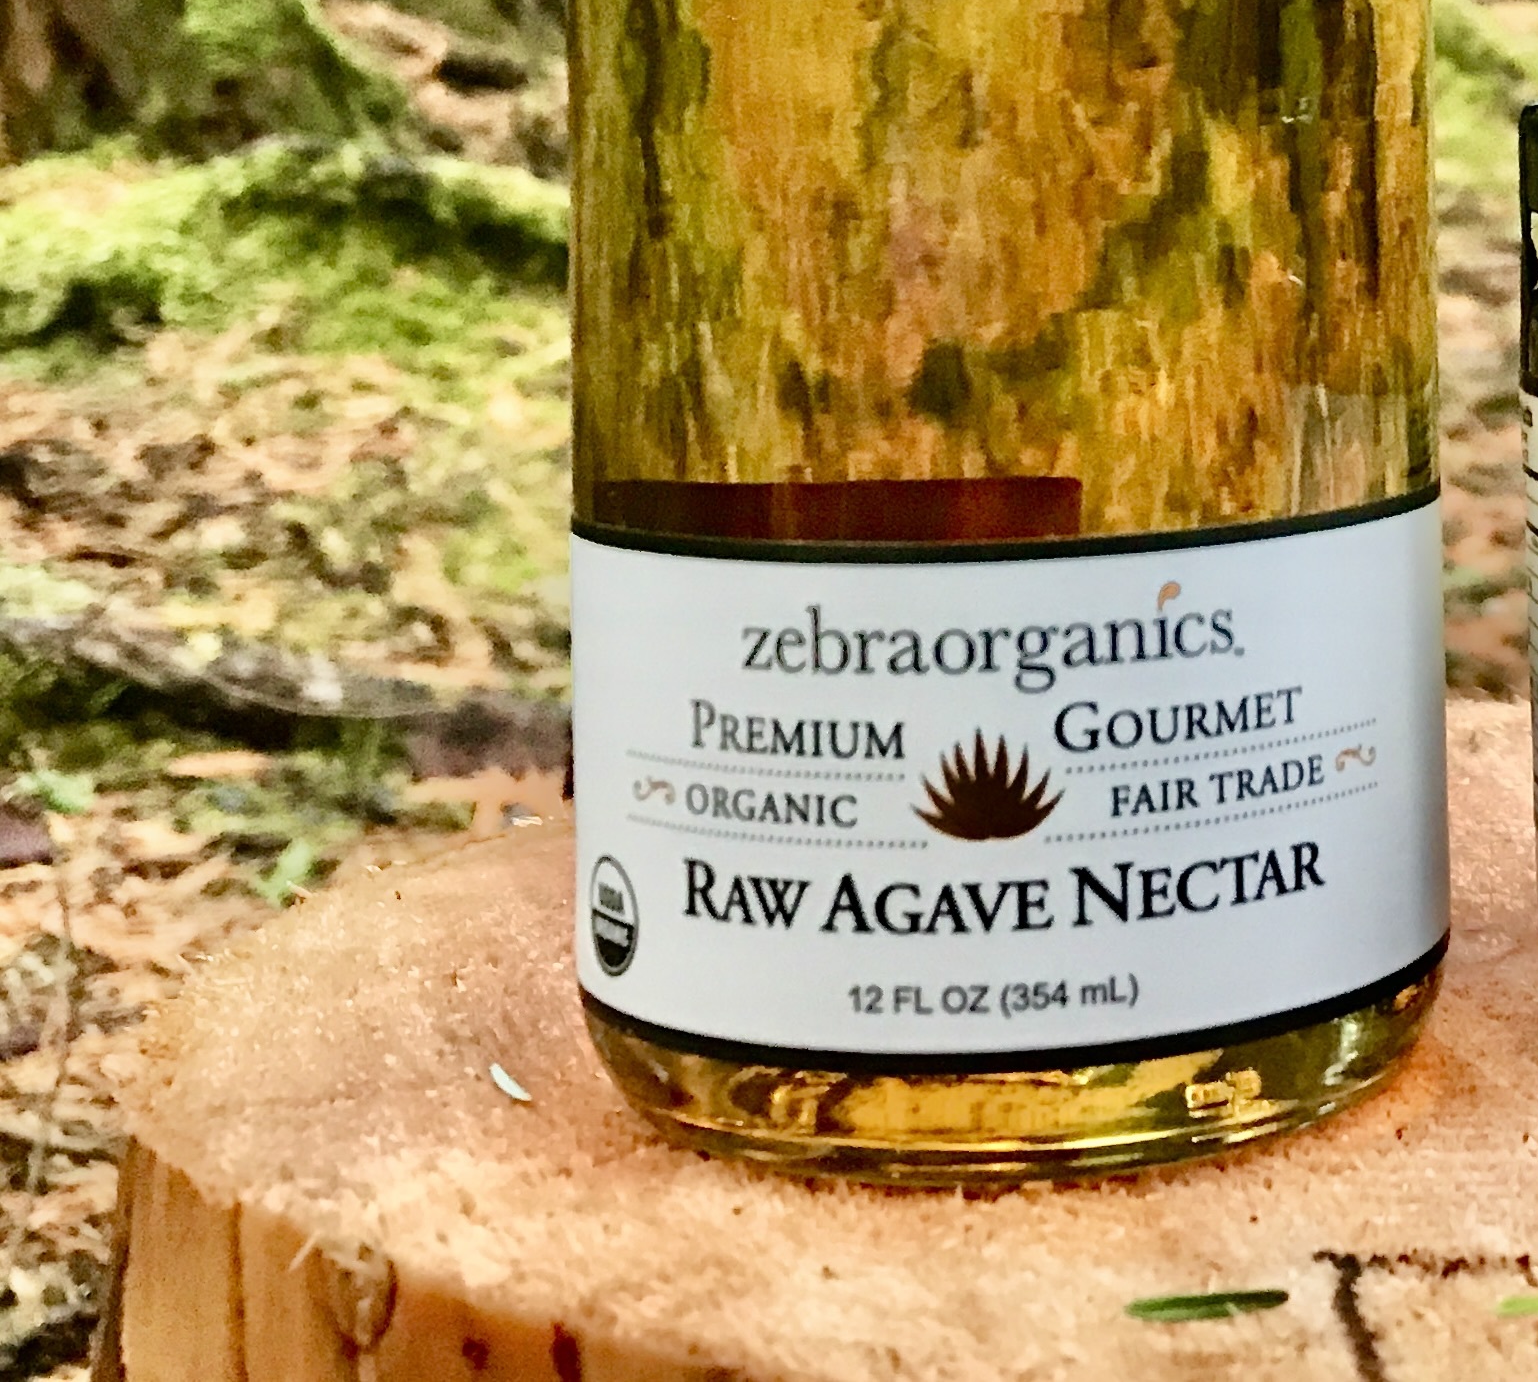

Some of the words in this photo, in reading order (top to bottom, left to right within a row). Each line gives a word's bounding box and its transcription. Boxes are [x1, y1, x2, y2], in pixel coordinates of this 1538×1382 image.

[741, 581, 1235, 695] zebraorganics
[690, 698, 907, 761] PREMIUM
[1053, 685, 1303, 755] GOURMET
[685, 782, 858, 830] ORGANIC
[1109, 777, 1201, 819] FAIR
[1208, 753, 1326, 806] TRADE
[681, 856, 813, 931] RAW
[817, 871, 1056, 938] AGAVE
[1067, 840, 1327, 929] NECTAR
[847, 983, 885, 1015] 12
[892, 984, 935, 1016] FL
[939, 983, 991, 1016] OZ
[999, 979, 1071, 1020] (354
[1078, 972, 1140, 1009] mL)
